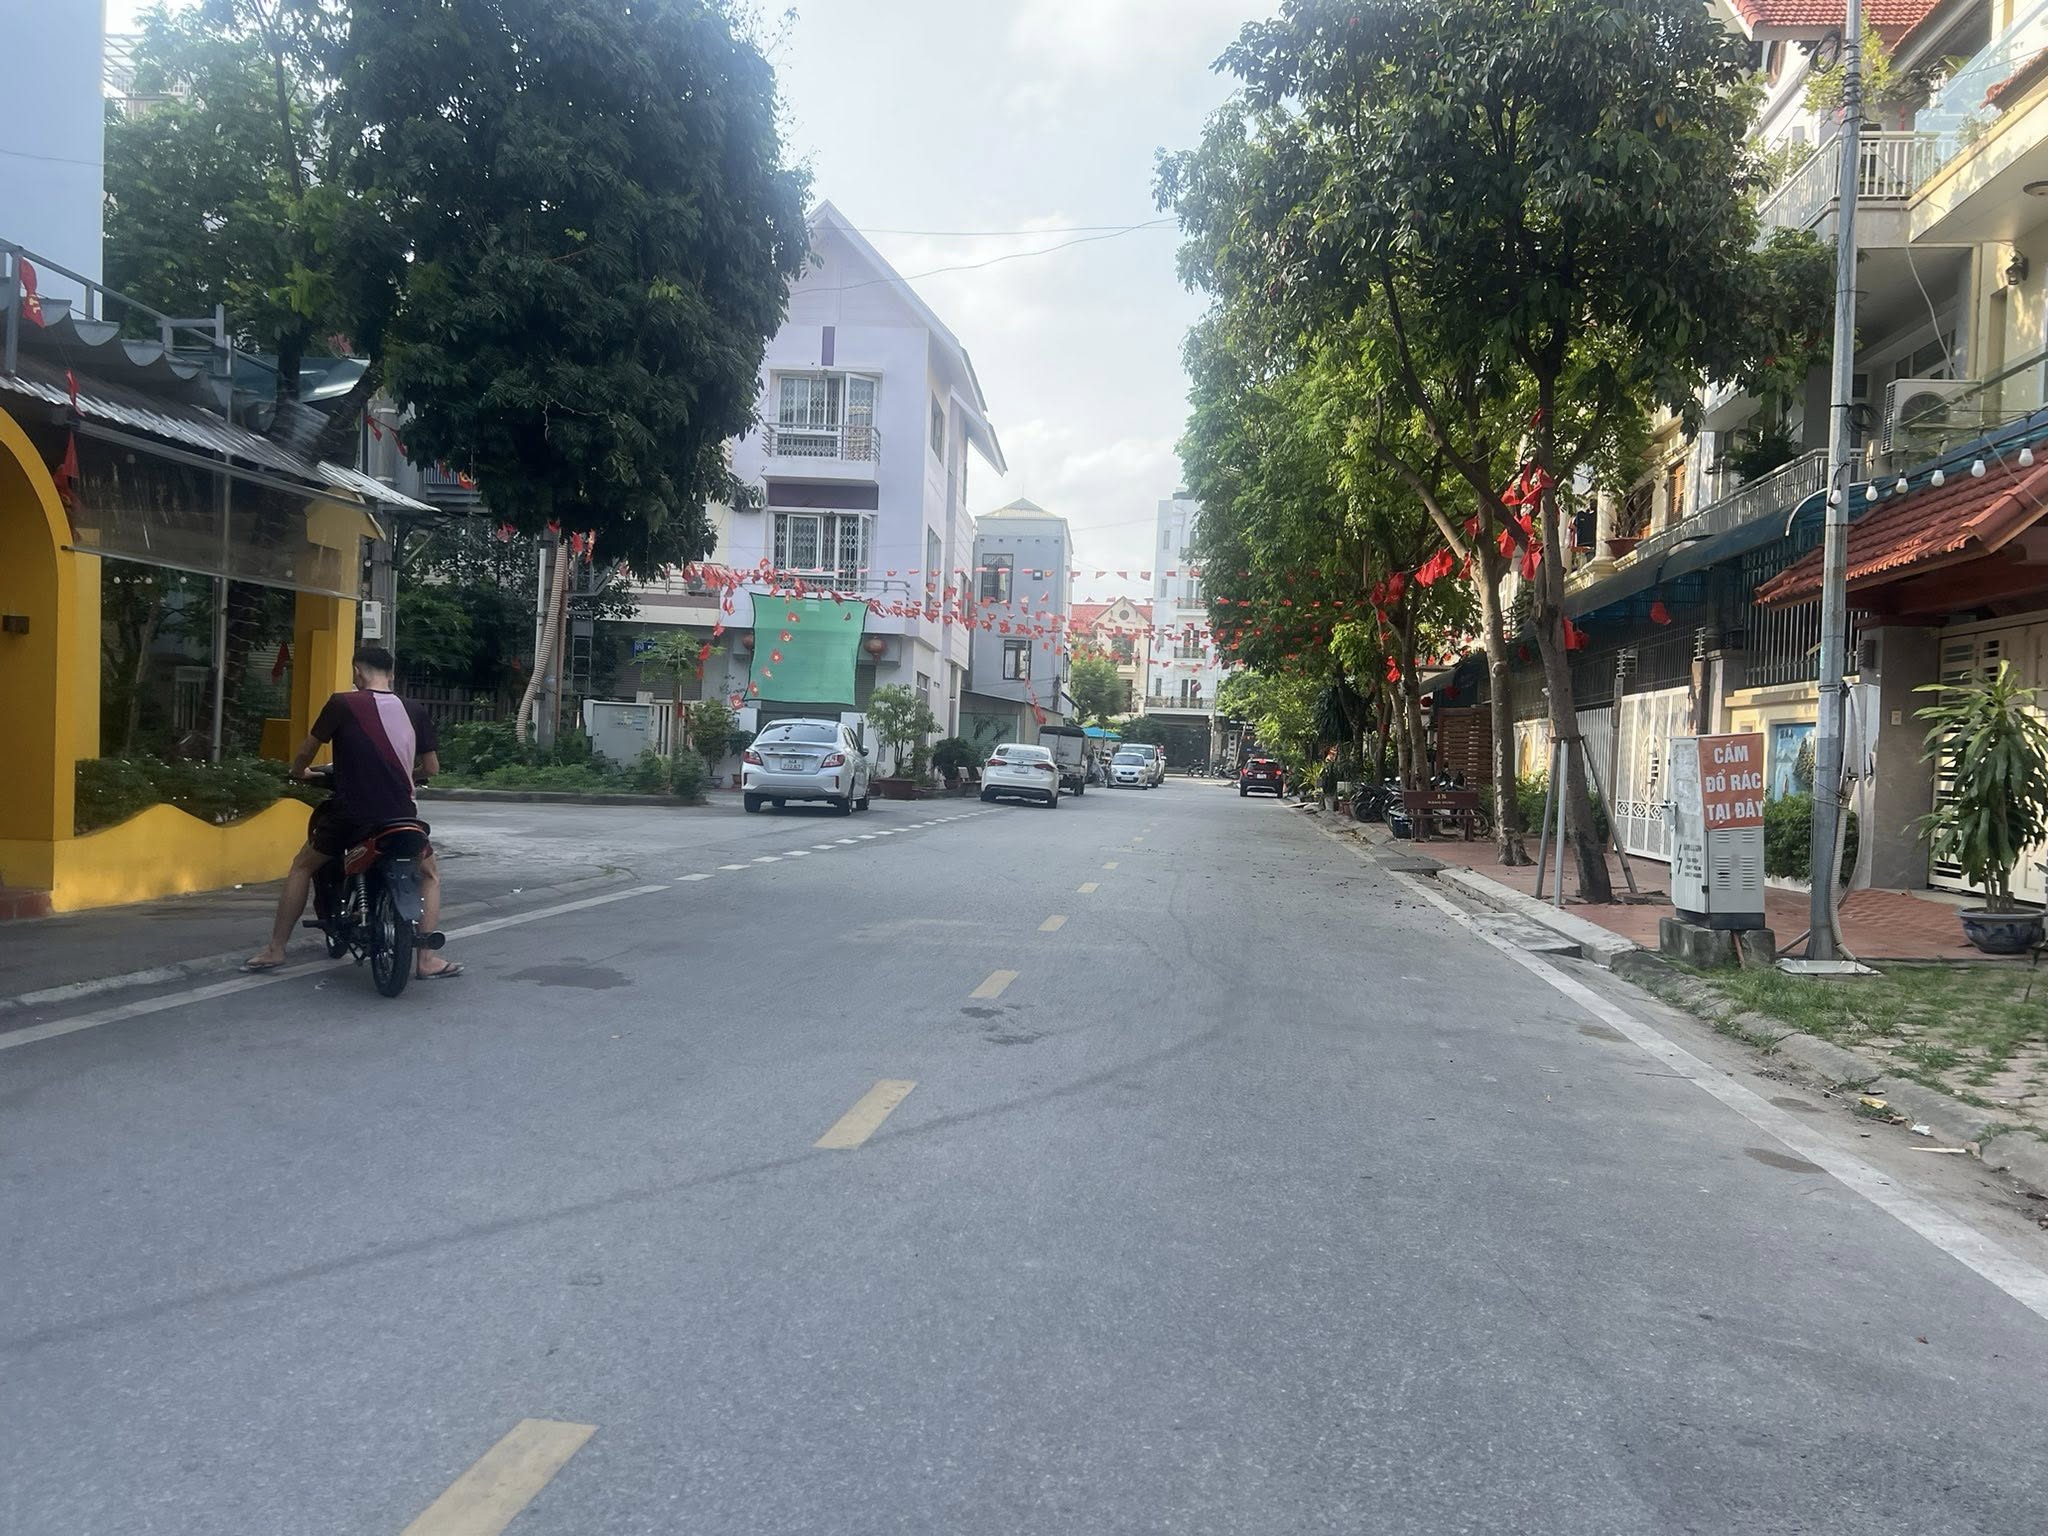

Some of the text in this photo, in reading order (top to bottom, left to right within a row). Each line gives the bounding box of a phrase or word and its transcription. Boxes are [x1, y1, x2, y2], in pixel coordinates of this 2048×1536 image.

[1714, 741, 1749, 764] CẤM
[1705, 768, 1761, 793] ĐỔ RÁC
[1707, 798, 1764, 824] TẠI ĐÂY
